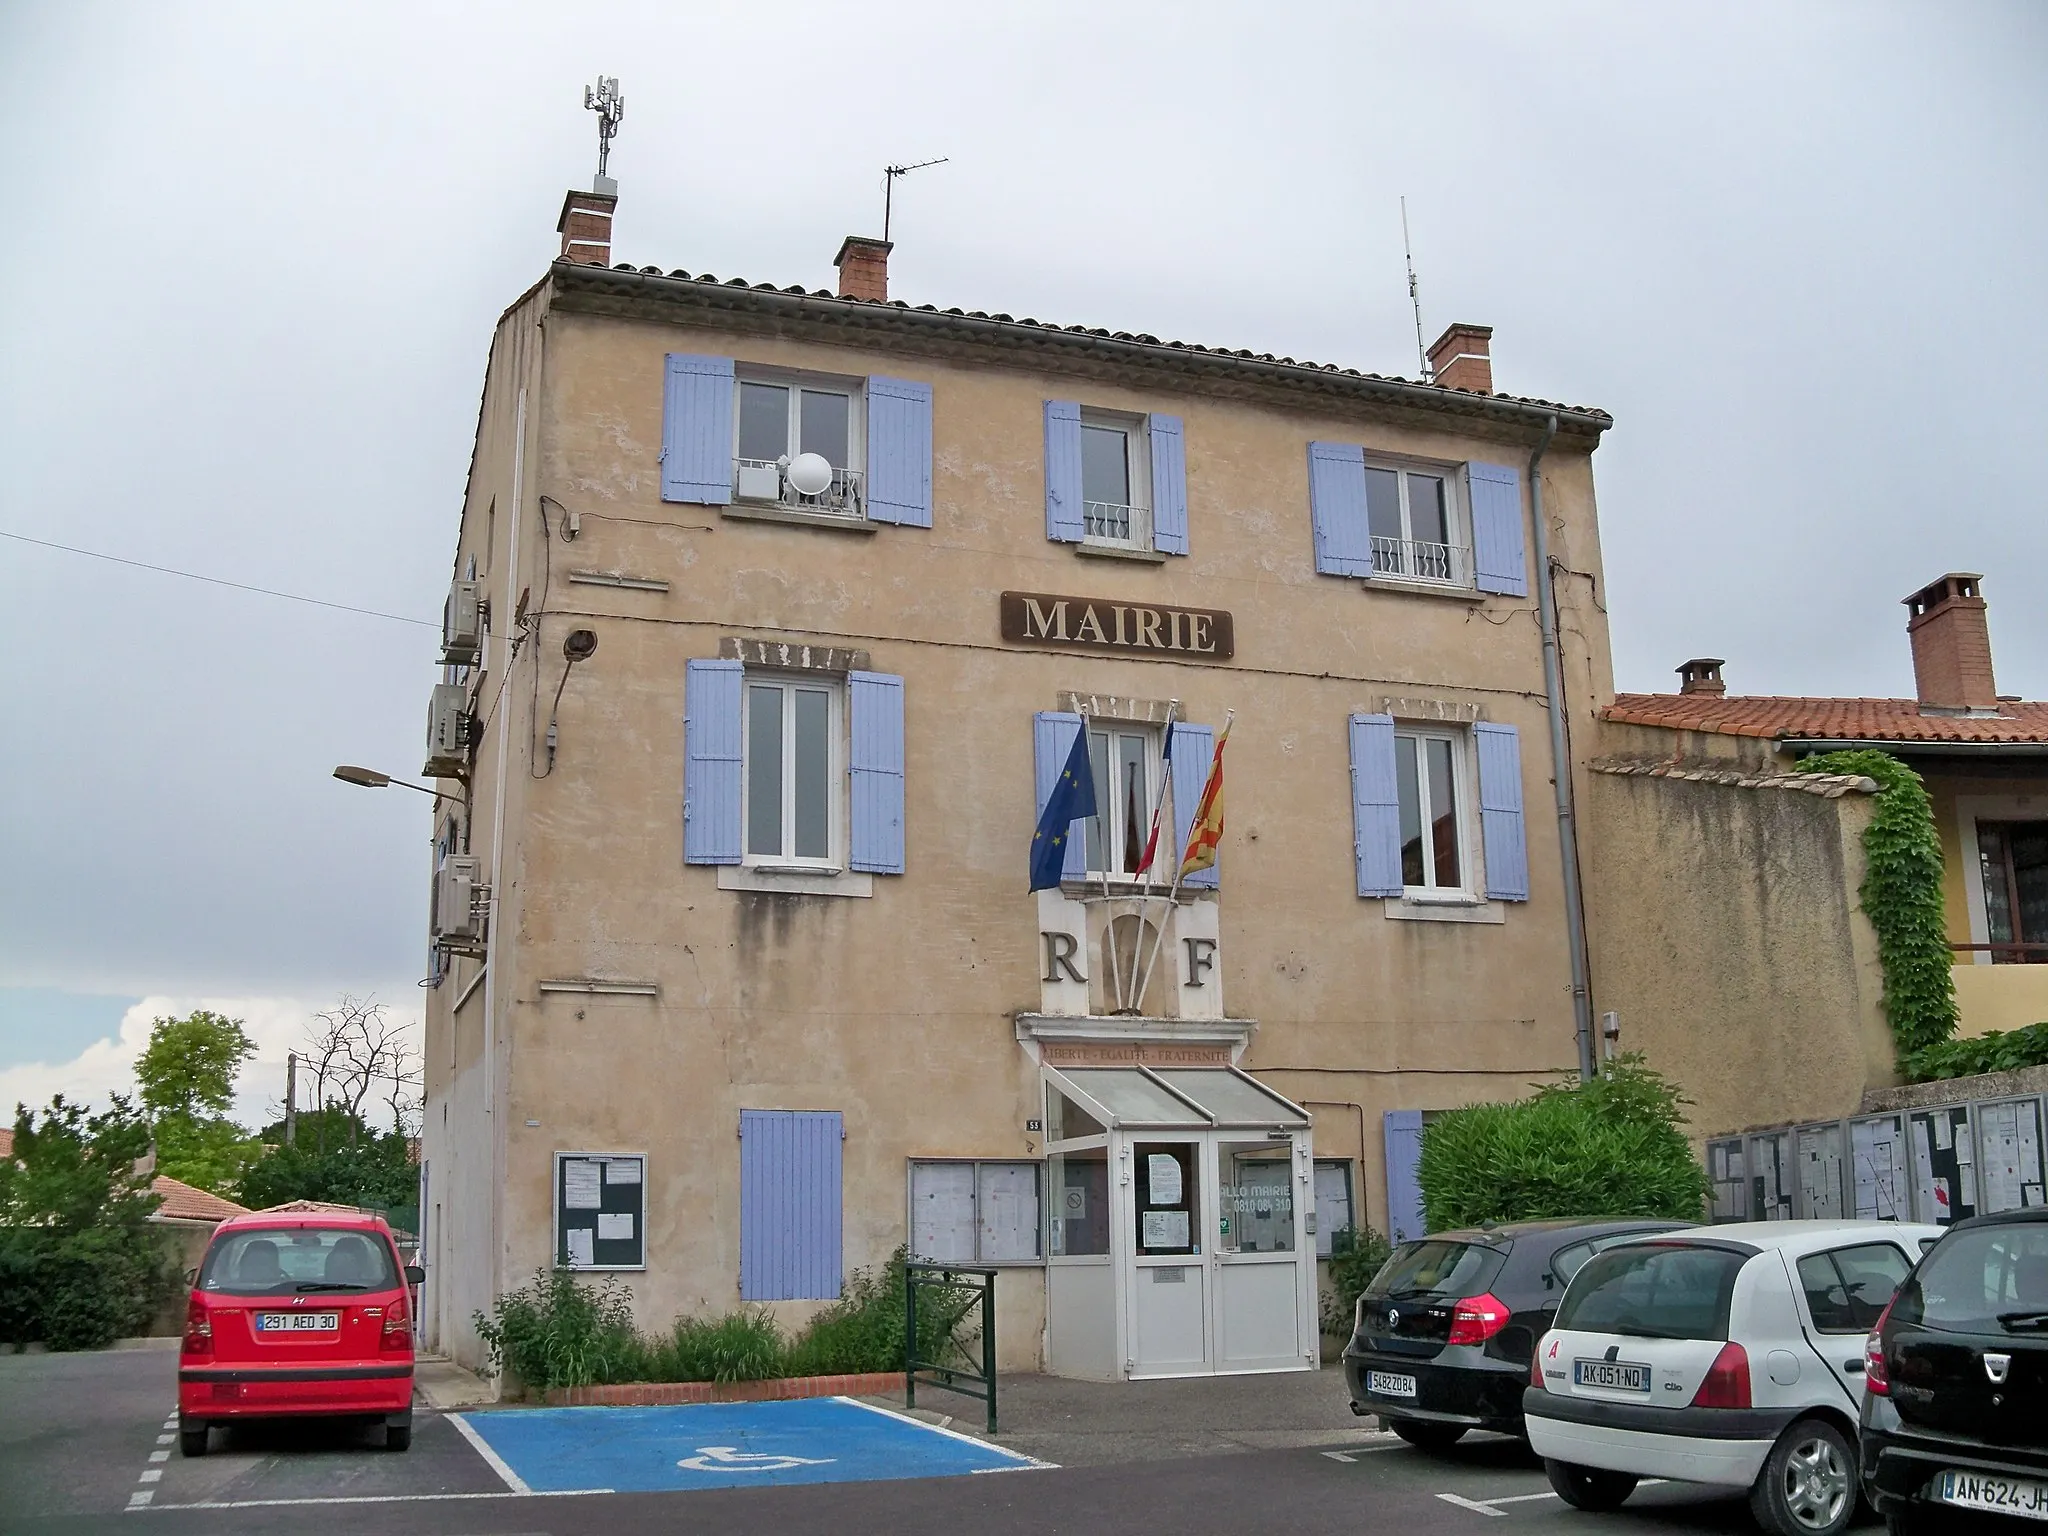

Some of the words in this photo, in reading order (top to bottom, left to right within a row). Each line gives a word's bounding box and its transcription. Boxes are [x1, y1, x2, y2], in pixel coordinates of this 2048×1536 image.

[1022, 598, 1216, 653] MAIRIE
[1040, 931, 1089, 983] R
[1182, 937, 1217, 987] F
[1220, 1186, 1248, 1197] ALLO
[1250, 1185, 1291, 1197] MAIRIE
[1234, 1199, 1256, 1213] 0810
[265, 1316, 287, 1329] 291
[320, 1316, 335, 1329] 30
